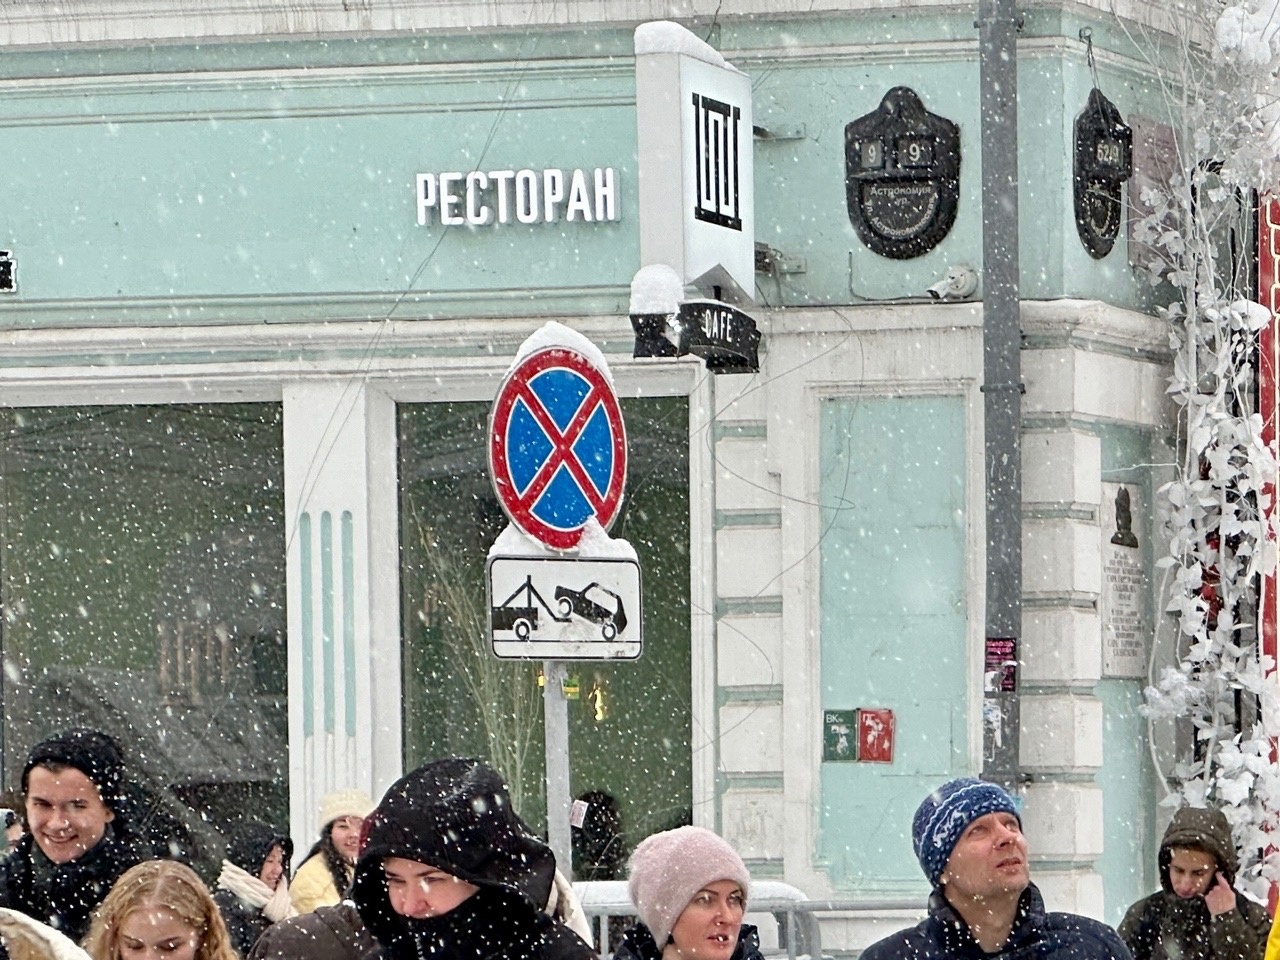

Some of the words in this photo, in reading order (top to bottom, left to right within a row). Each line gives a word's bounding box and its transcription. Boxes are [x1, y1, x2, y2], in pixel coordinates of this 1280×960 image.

[868, 145, 876, 163] 9
[909, 143, 920, 161] 9
[416, 167, 615, 226] РЕСТОРАН
[704, 308, 734, 343] CAFE
